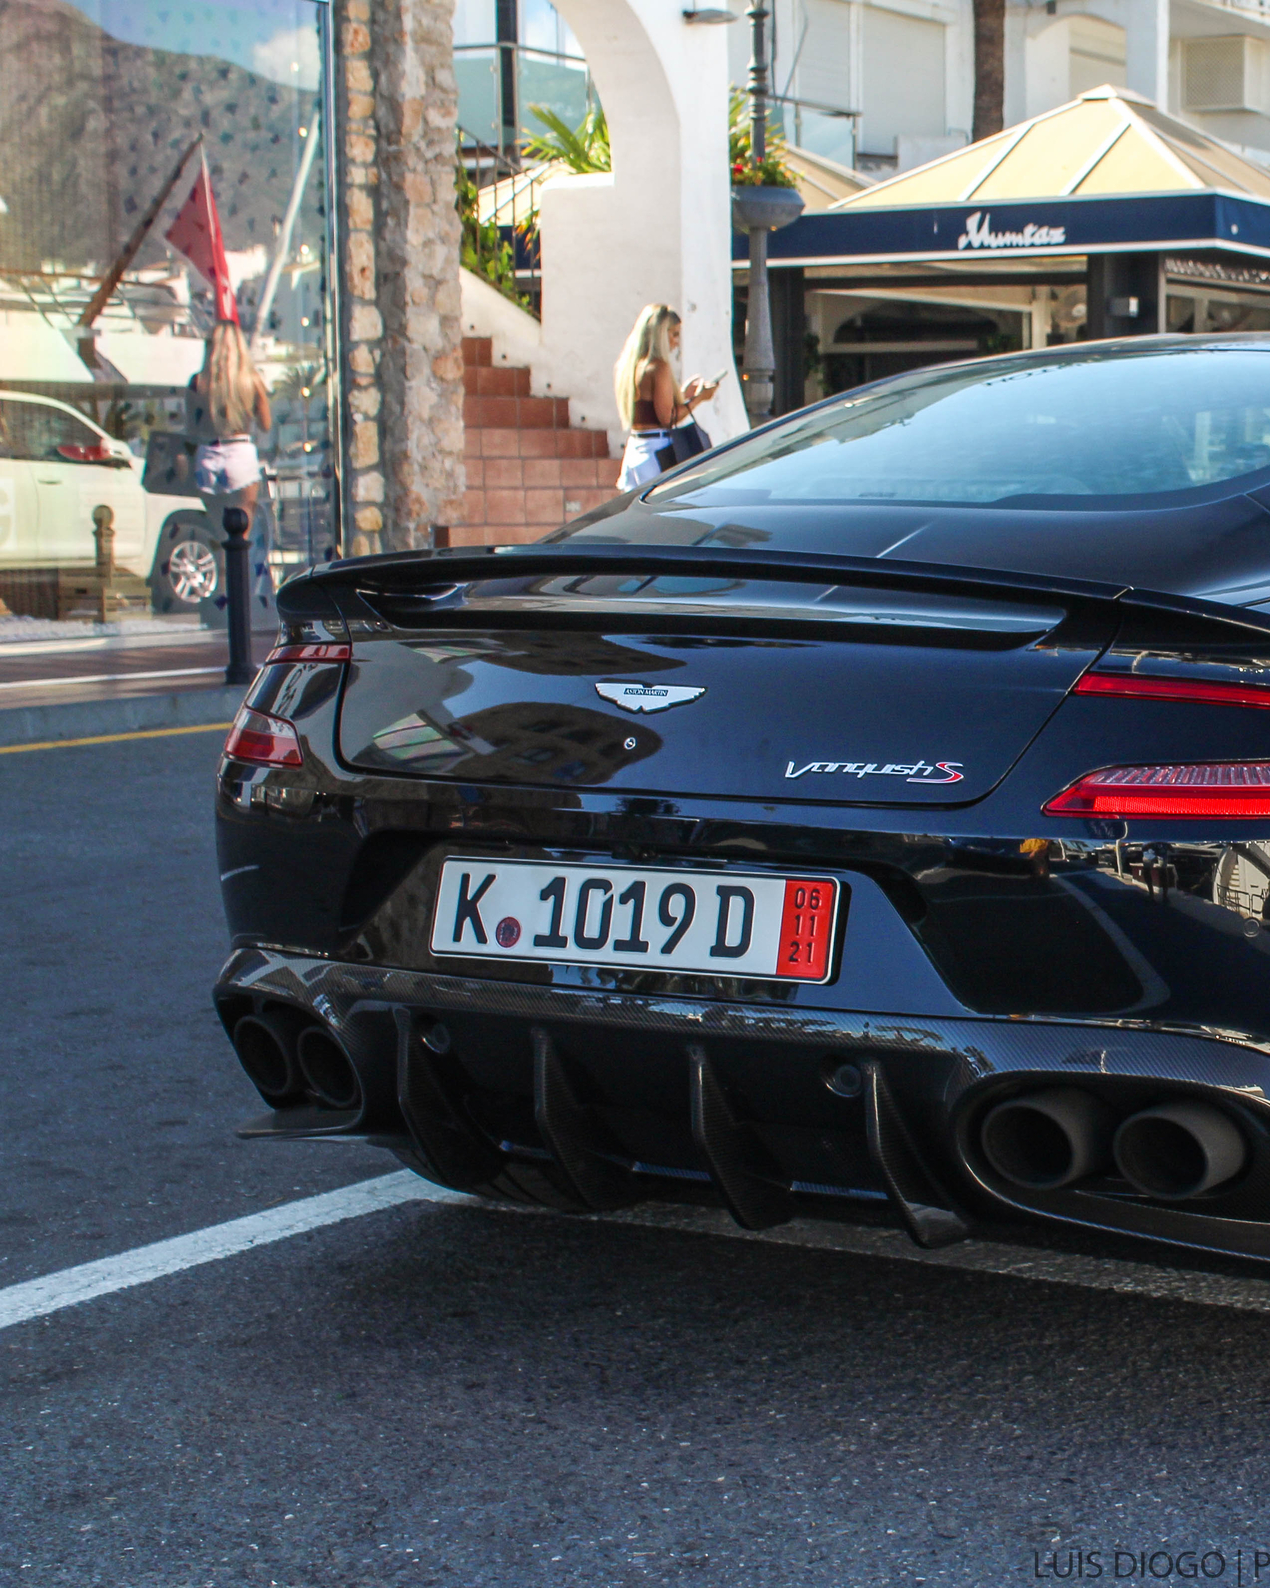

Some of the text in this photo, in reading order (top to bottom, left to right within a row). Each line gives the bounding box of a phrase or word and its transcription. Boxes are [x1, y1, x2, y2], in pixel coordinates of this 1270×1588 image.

[958, 211, 1066, 250] Mumtaz
[906, 761, 964, 784] S
[794, 888, 821, 909] 06
[453, 873, 755, 958] K 1019 D
[795, 914, 817, 937] 11
[788, 941, 815, 964] 21
